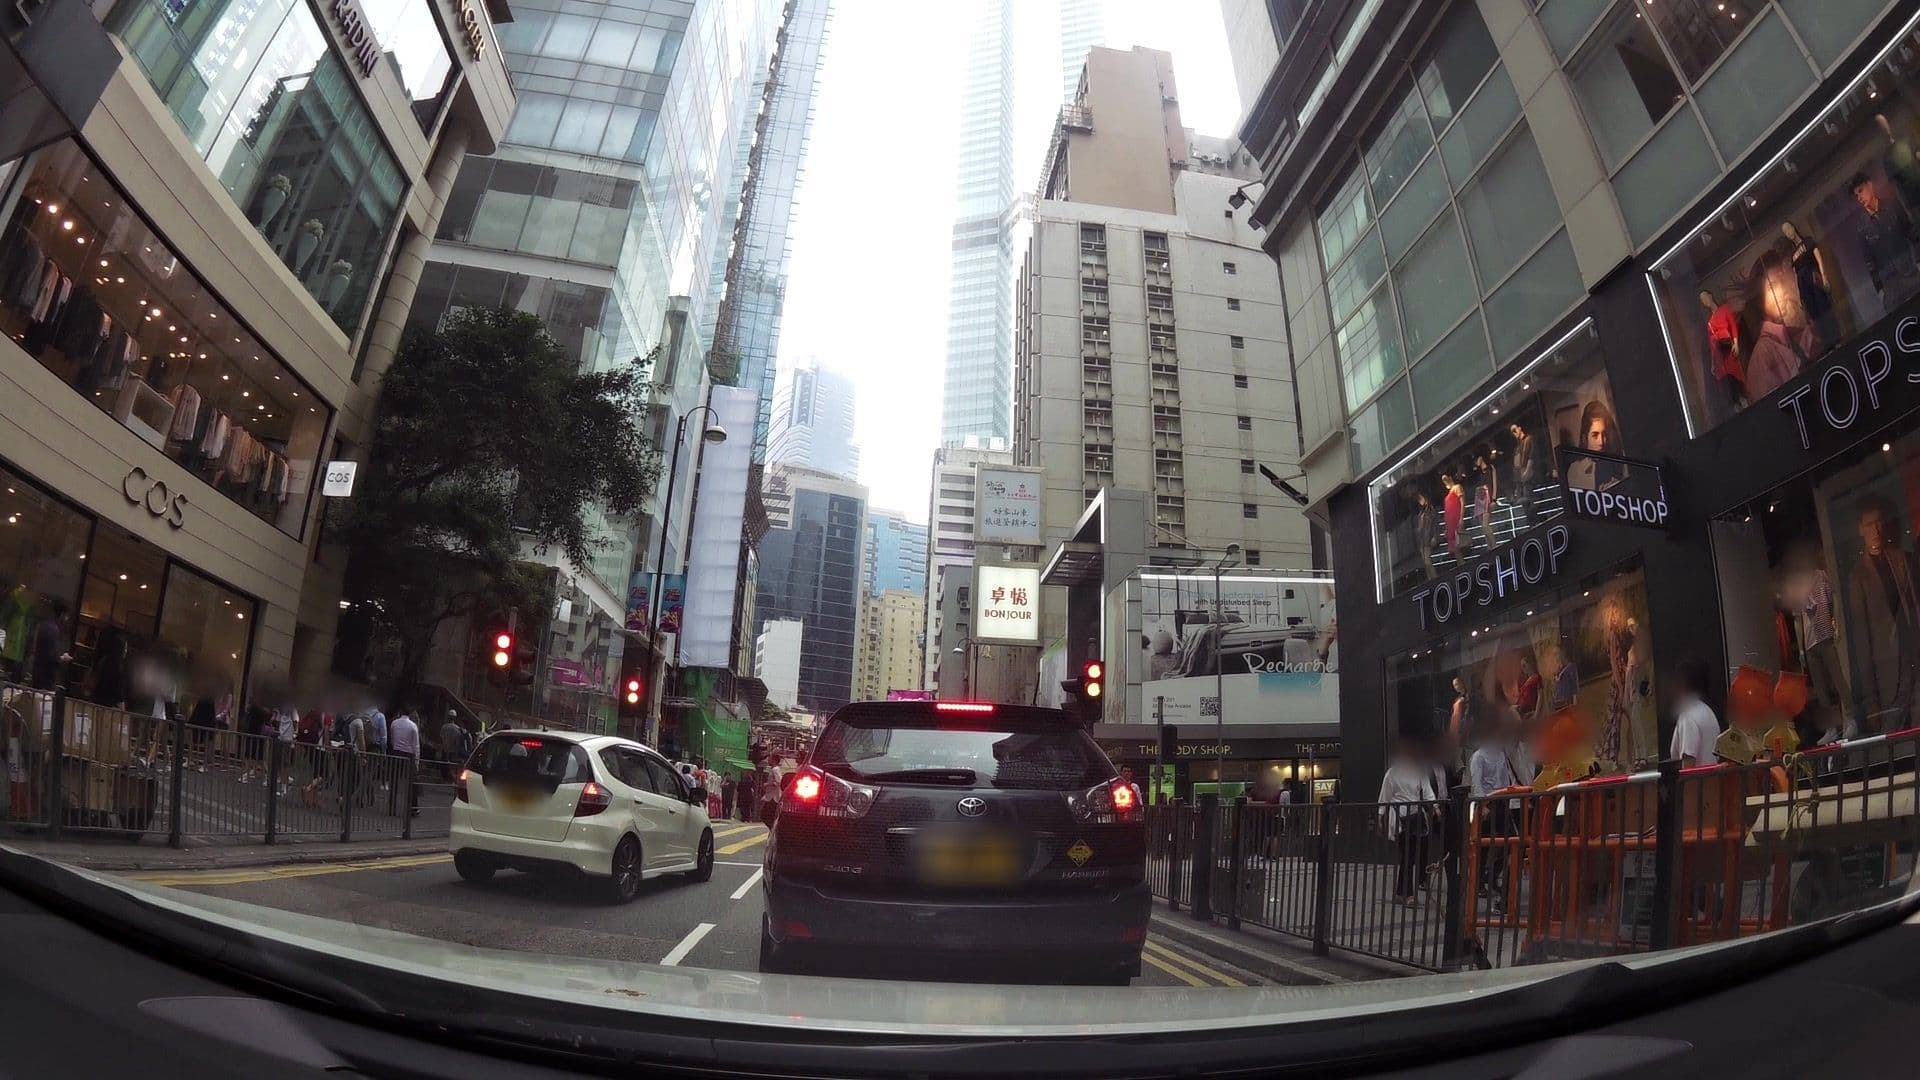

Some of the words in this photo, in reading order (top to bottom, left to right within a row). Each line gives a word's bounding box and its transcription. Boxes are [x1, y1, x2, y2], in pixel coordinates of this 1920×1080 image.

[1778, 316, 1920, 449] TOPS
[327, 472, 350, 483] COS
[124, 466, 188, 527] COS
[1569, 487, 1668, 525] TOPSHOP
[1412, 525, 1569, 631] TOPSHOP
[984, 609, 1032, 620] BONJOUR
[1242, 652, 1336, 684] Recharge
[1139, 745, 1160, 755] THE
